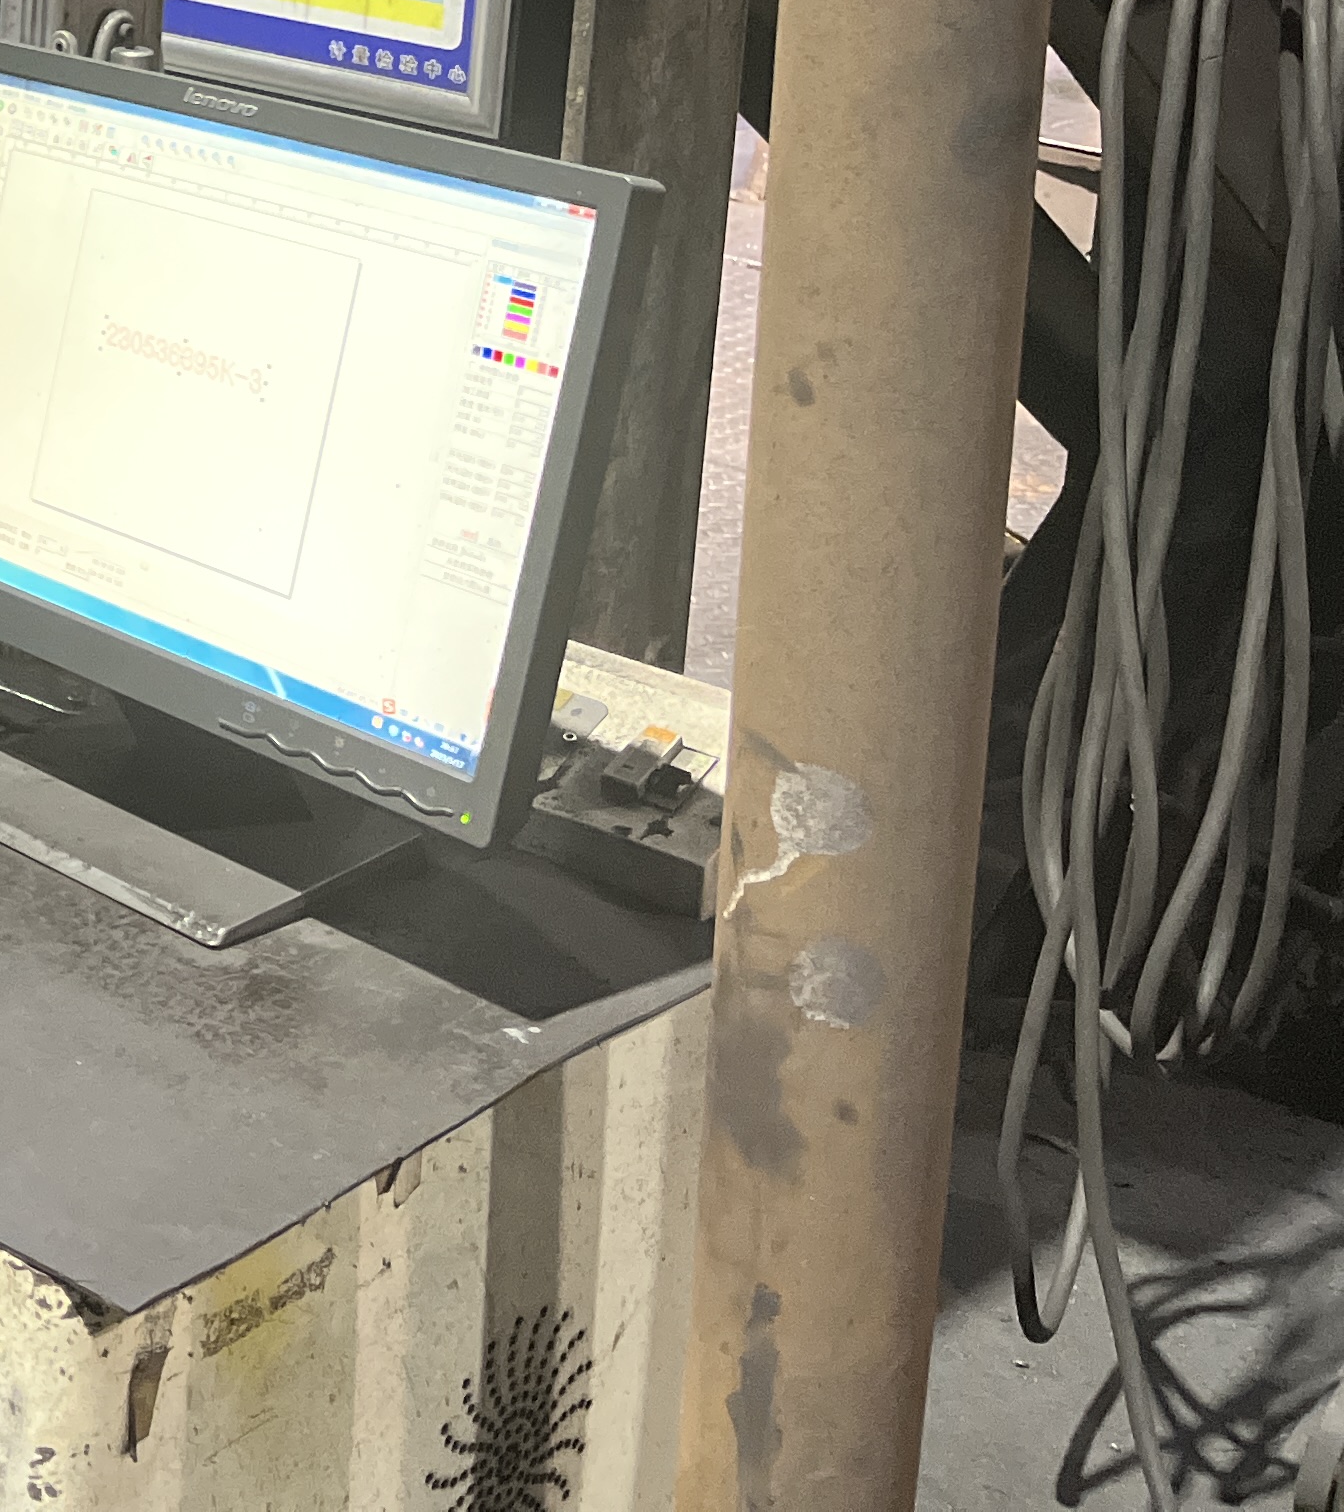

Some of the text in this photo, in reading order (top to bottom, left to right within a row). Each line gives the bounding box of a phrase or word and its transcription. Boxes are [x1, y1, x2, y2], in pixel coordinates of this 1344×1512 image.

[329, 39, 466, 85] 计量检验中心
[183, 87, 259, 117] lenovo
